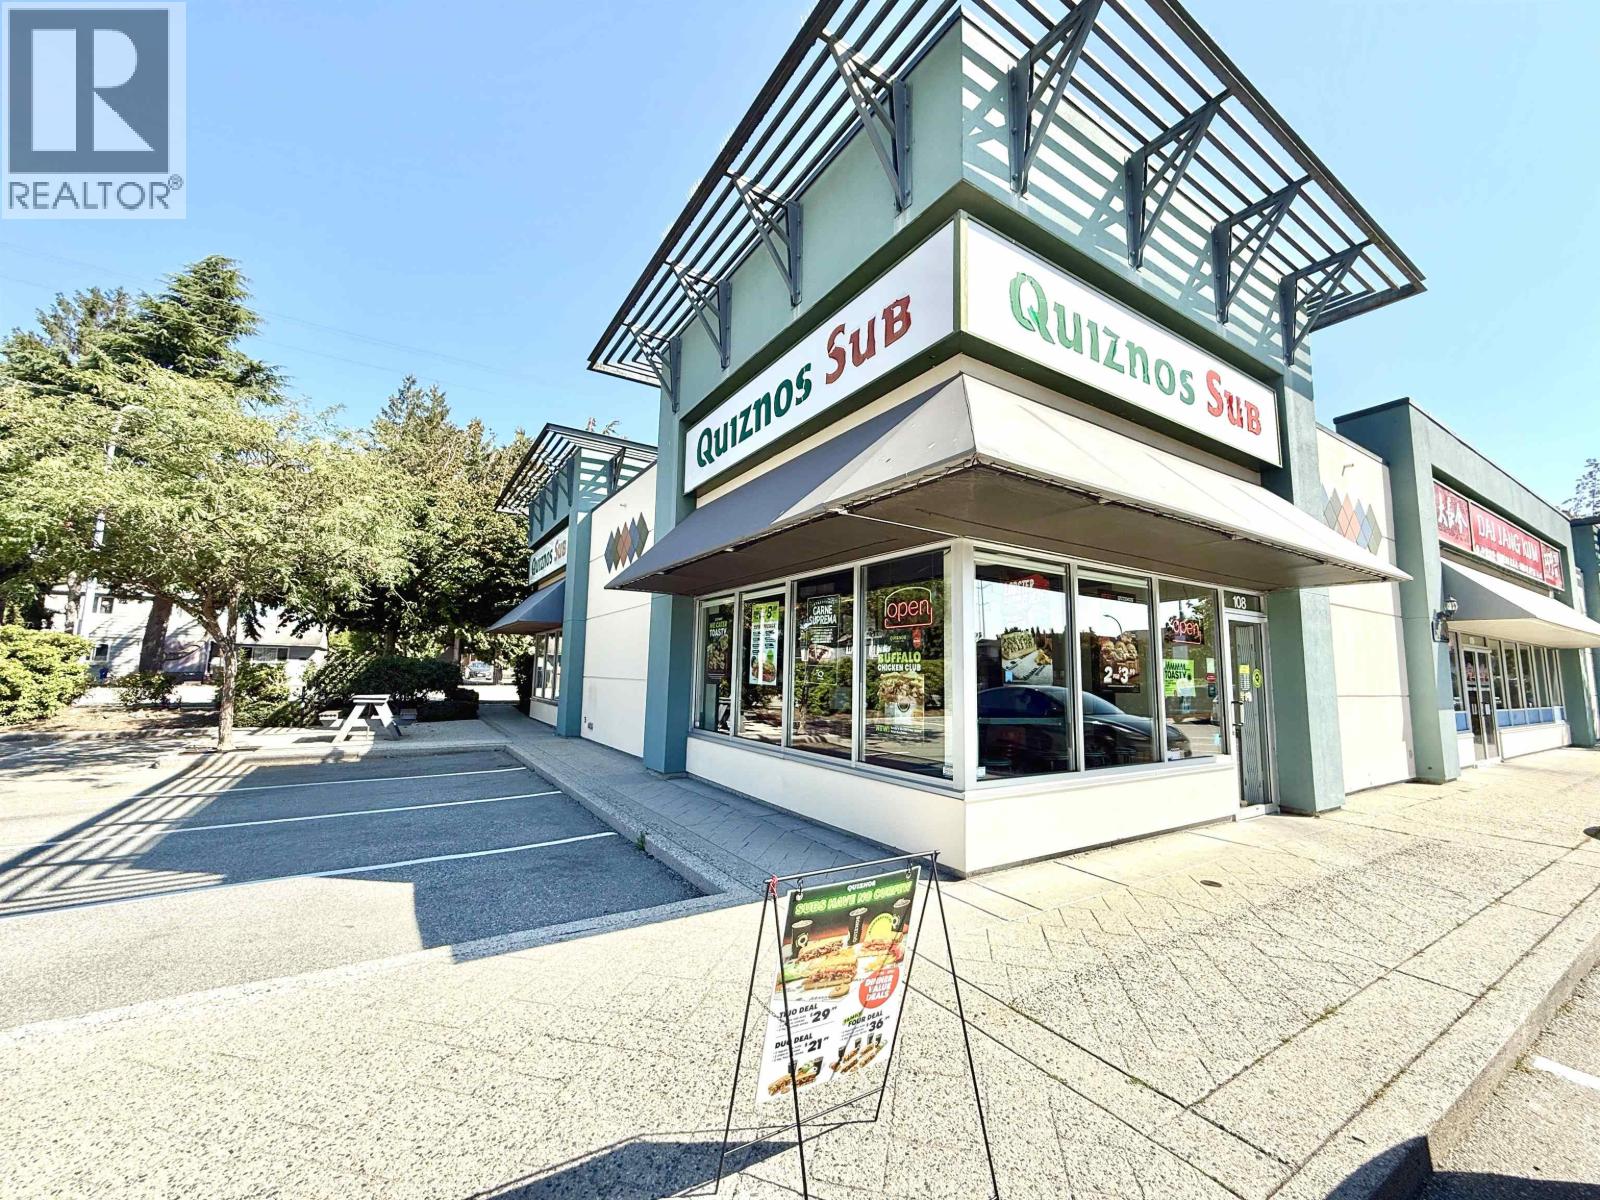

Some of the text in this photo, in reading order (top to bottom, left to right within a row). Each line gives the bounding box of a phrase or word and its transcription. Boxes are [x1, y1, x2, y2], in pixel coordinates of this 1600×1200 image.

[1232, 595, 1247, 610] 108
[812, 605, 833, 616] CARNE
[887, 599, 930, 622] open
[809, 614, 837, 625] SUPREMA
[1172, 620, 1200, 637] open
[878, 651, 922, 664] BUFFALO
[877, 663, 922, 672] CHICKEN CLUB
[1103, 666, 1113, 684] 2
[1164, 670, 1187, 680] TOASTY
[794, 899, 827, 916] SUBS
[799, 1003, 818, 1014] DEAL
[848, 1009, 883, 1027] FOUR DEAL
[794, 1032, 813, 1044] DEAL
